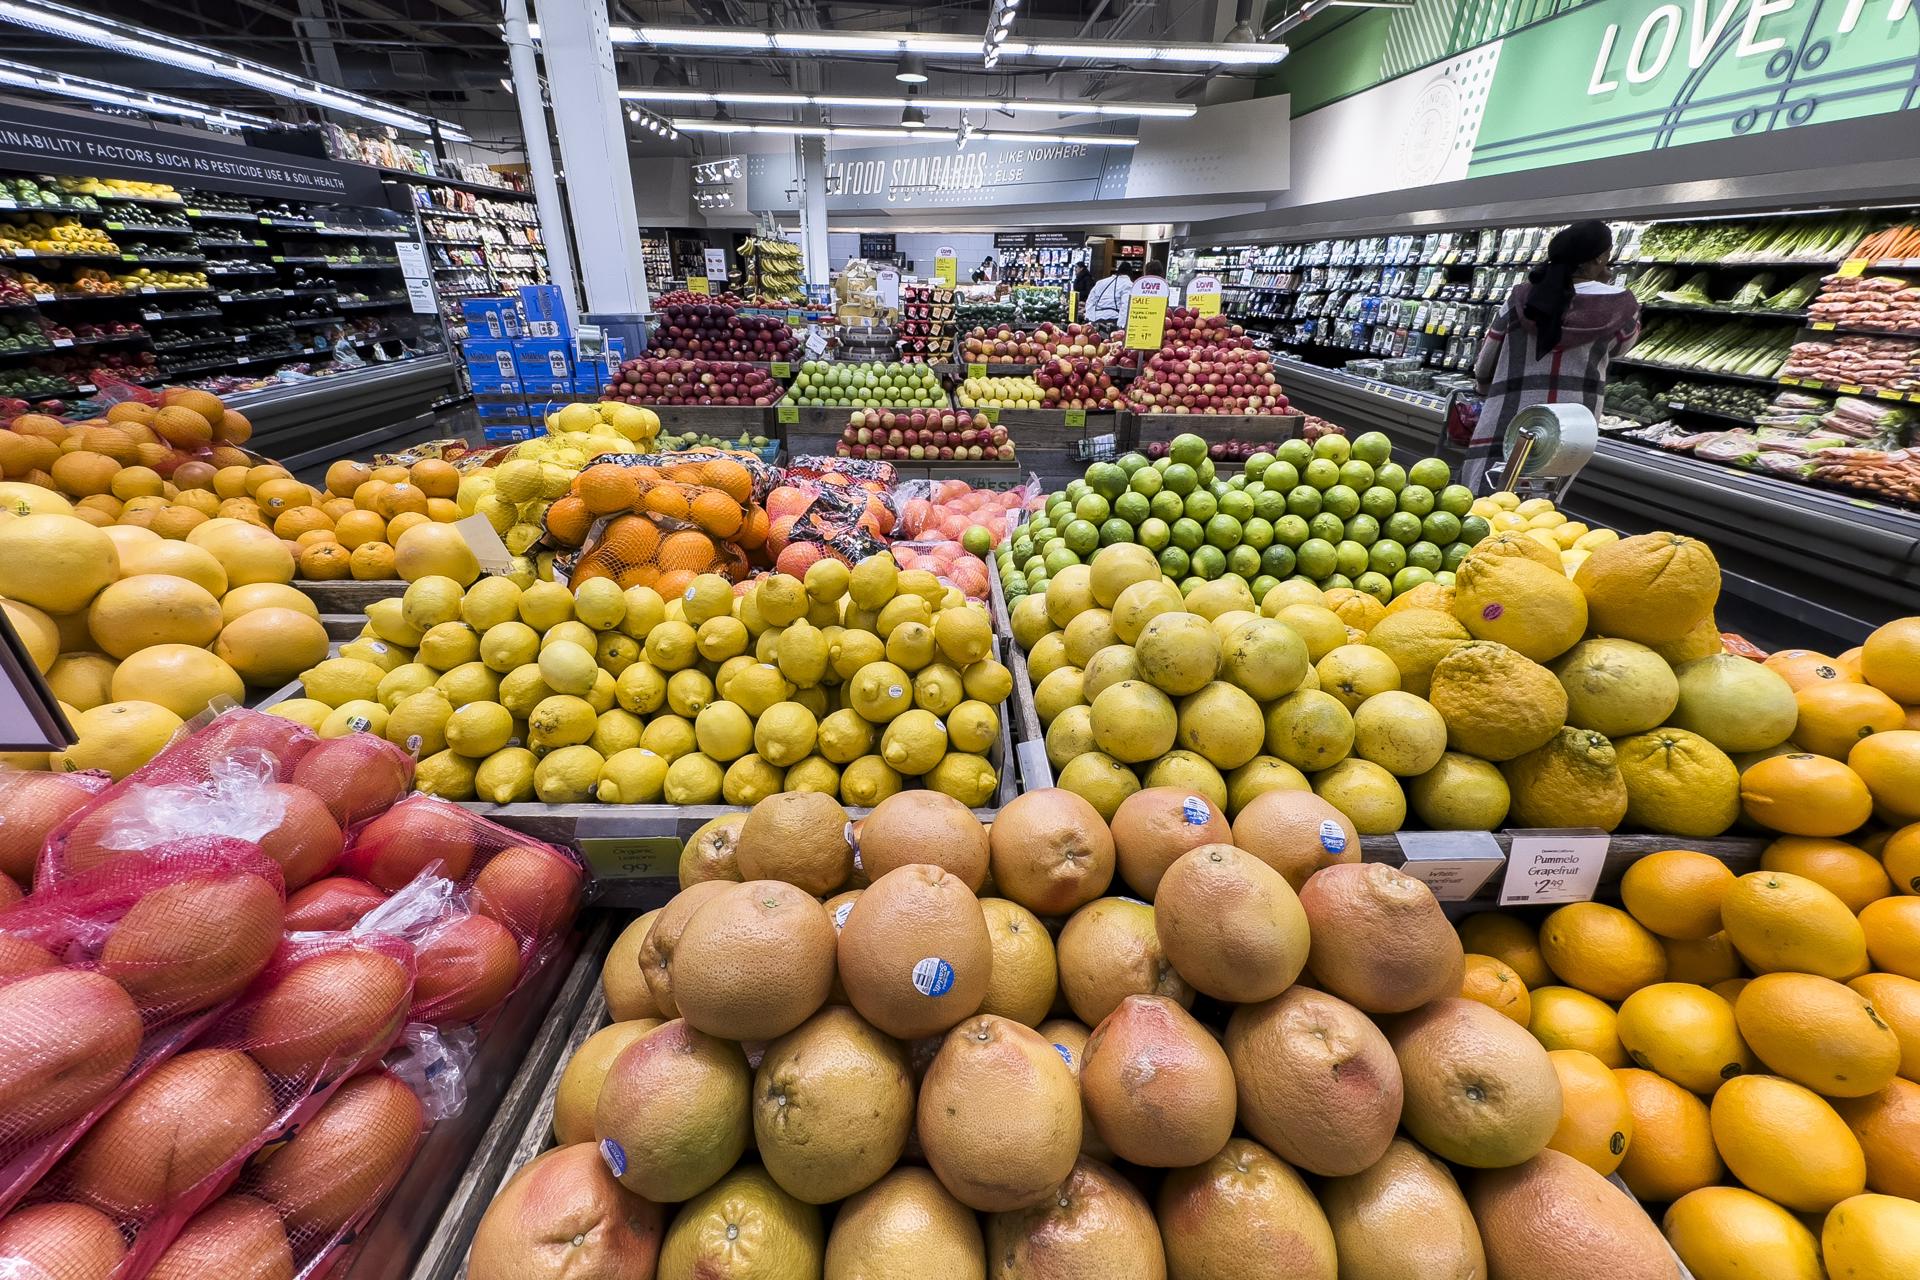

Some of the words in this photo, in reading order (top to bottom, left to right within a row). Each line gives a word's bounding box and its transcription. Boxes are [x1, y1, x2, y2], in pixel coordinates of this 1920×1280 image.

[1587, 0, 1796, 95] LOVE
[0, 130, 82, 154] INABILITY
[87, 142, 153, 163] FACTORS
[156, 152, 191, 168] SUCH
[194, 158, 210, 171] AS
[211, 160, 263, 178] PESTICIDE
[264, 169, 283, 181] USE
[285, 171, 292, 182] &
[293, 173, 313, 185] SOIL
[314, 176, 345, 189] HEALTH
[998, 151, 1023, 164] LIKE
[1027, 144, 1087, 162] NOWHERE
[825, 160, 885, 195] EAFOOD
[890, 151, 988, 193] STANDARDS
[995, 168, 1023, 182] ELSE
[1141, 282, 1160, 290] LOVE
[1132, 297, 1150, 305] SALE
[1534, 855, 1580, 865] Pummelo
[1528, 865, 1579, 876] Grapefruit
